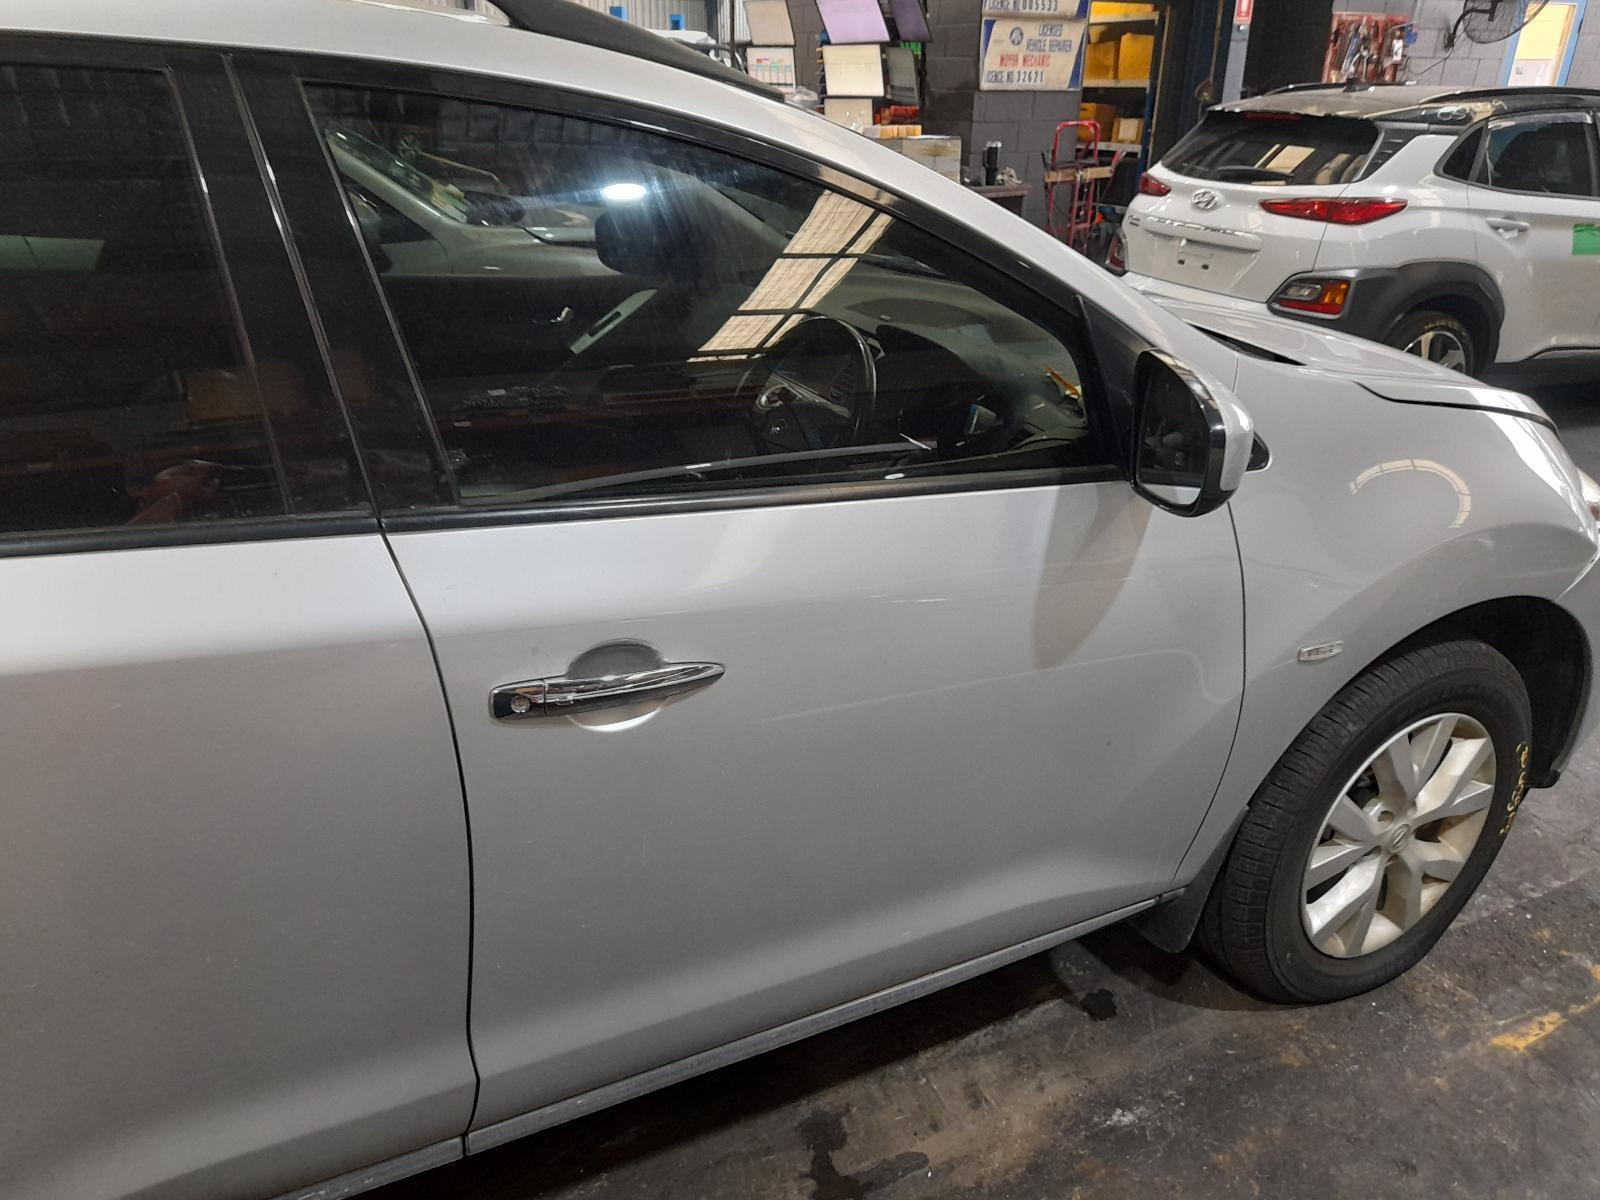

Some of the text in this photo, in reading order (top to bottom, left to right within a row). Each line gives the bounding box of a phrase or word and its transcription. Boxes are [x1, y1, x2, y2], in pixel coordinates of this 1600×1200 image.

[1026, 38, 1073, 53] VEHICLE REPAIRER
[1000, 53, 1051, 67] MOTOR MECHANIC
[1016, 70, 1044, 83] 32621
